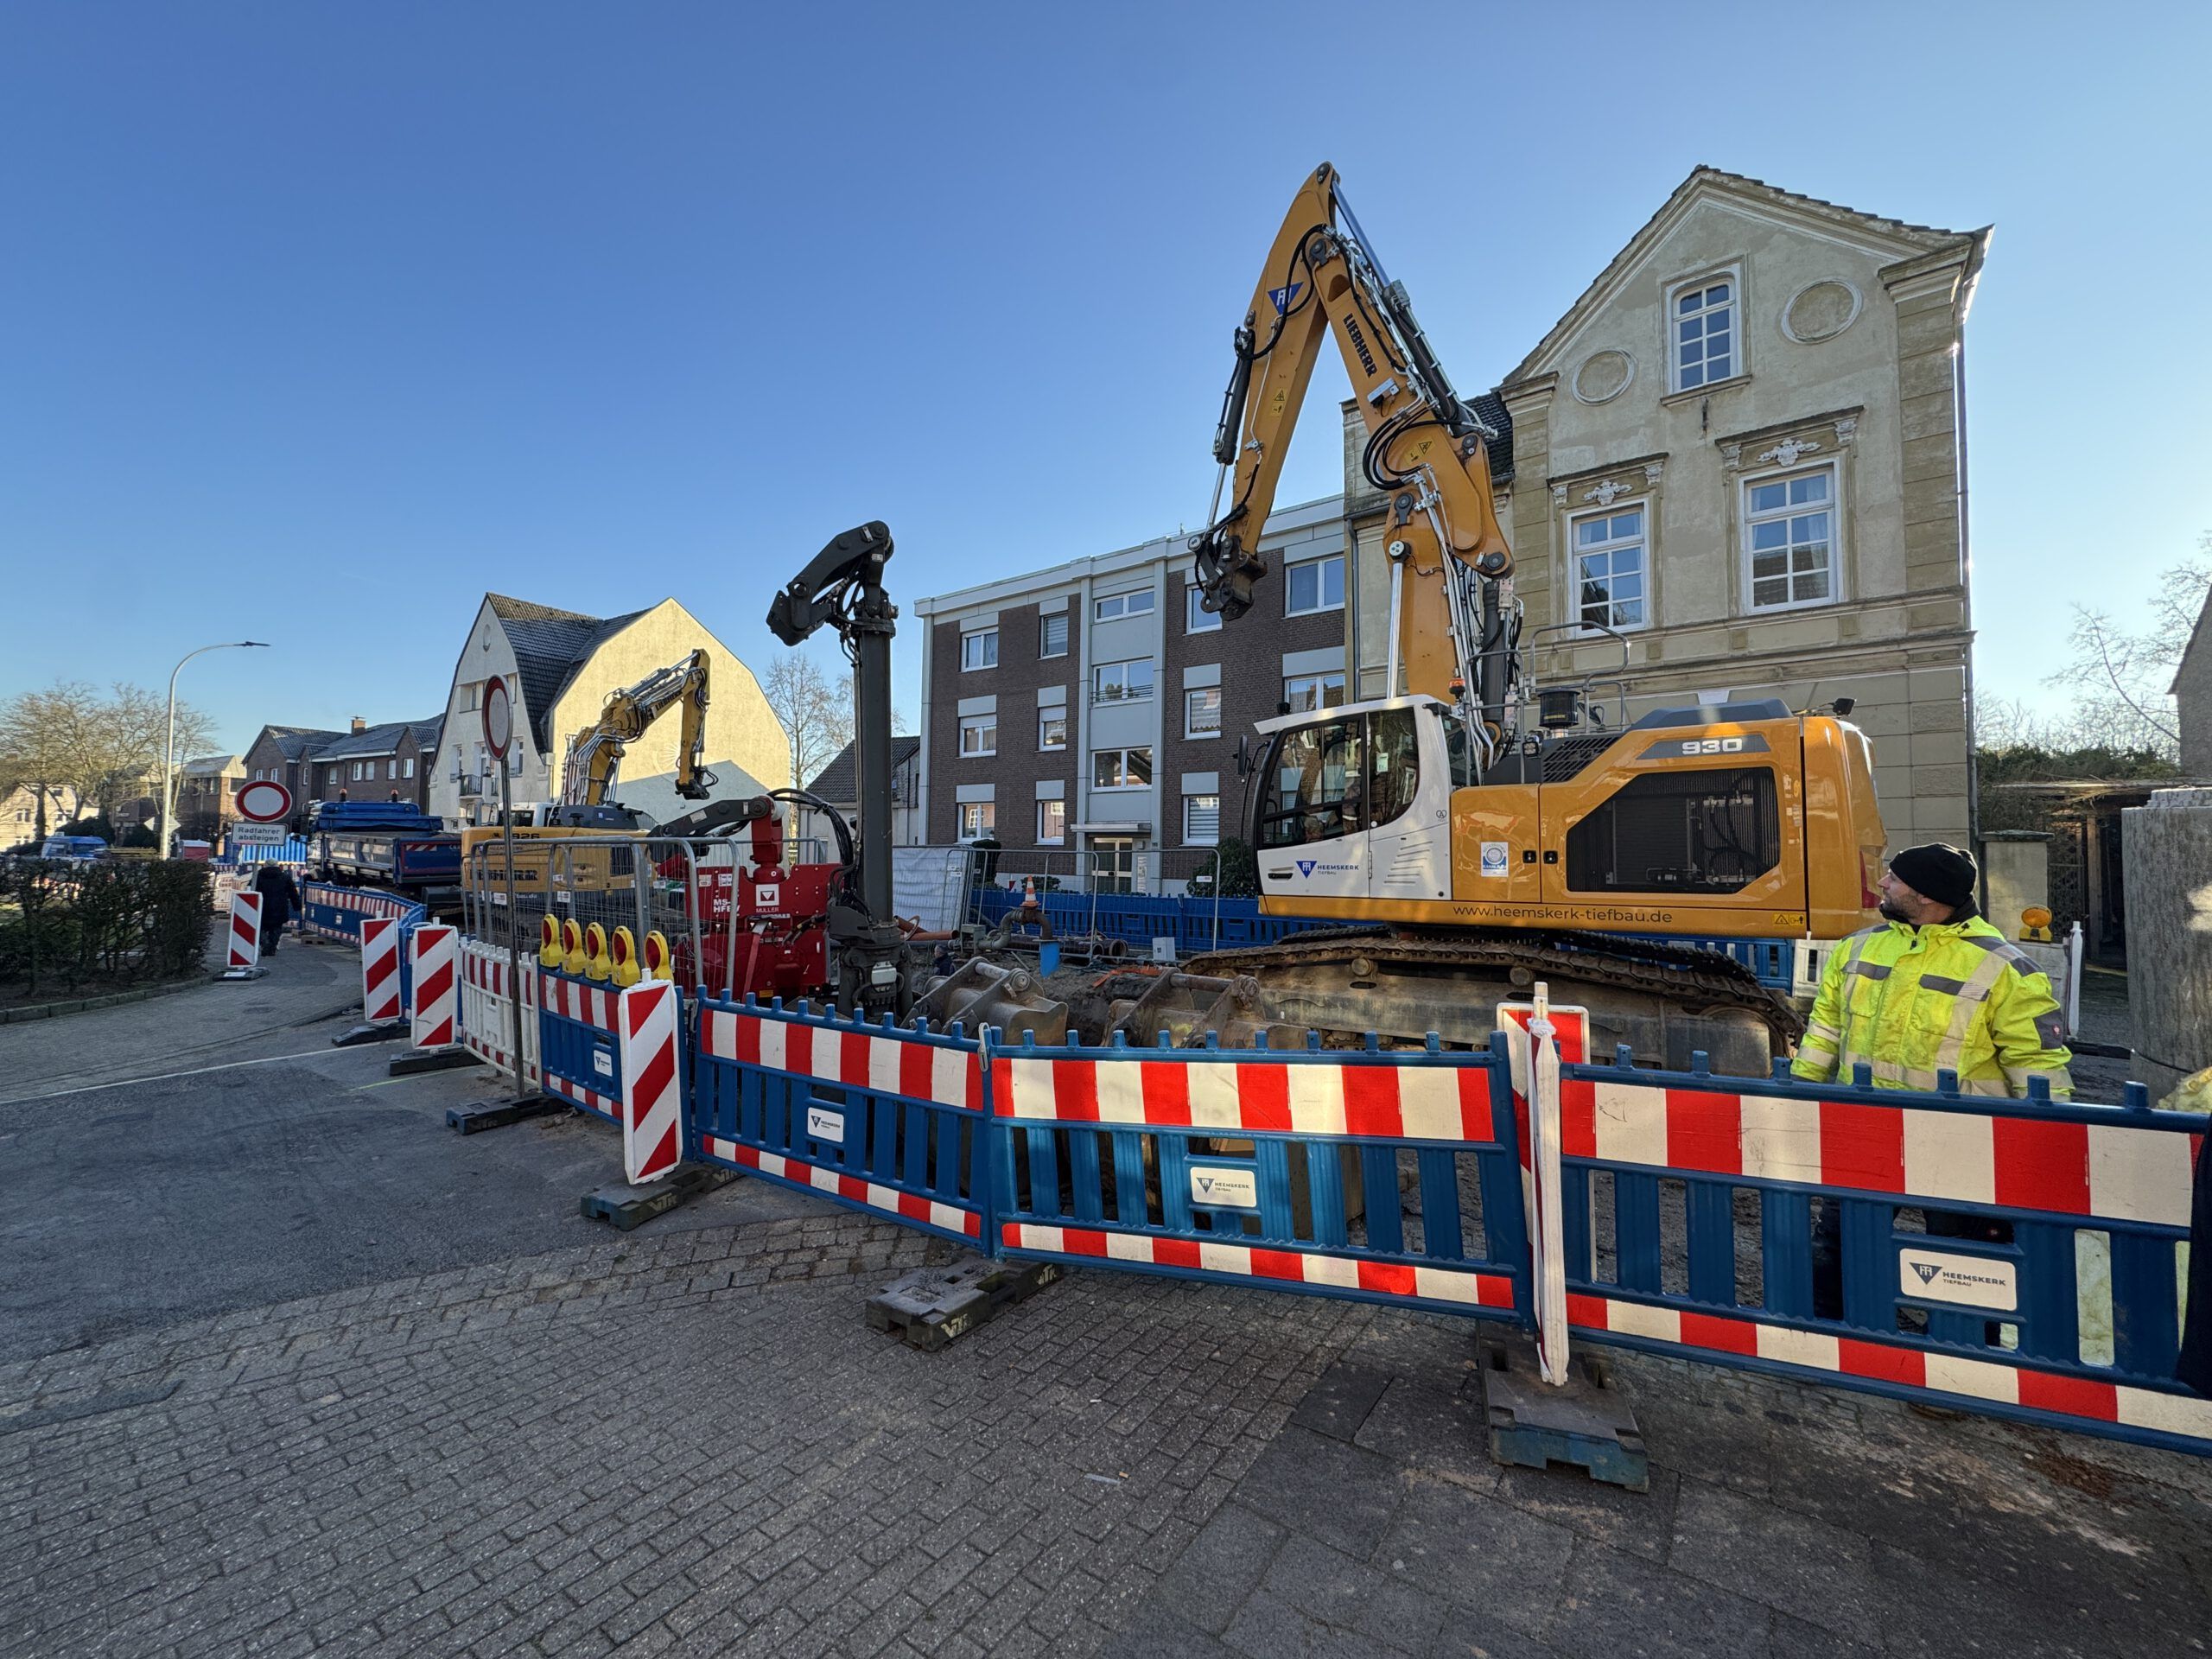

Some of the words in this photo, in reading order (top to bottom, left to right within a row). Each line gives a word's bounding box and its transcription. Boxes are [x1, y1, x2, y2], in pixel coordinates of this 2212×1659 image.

[1343, 313, 1378, 378] LIEBHERR
[1681, 738, 1743, 755] 930
[1452, 905, 1673, 924] www.heemskerk-tiefbau.de
[1942, 1271, 2006, 1287] HEEMSKERK
[1943, 1278, 1972, 1287] TIEFBAU
